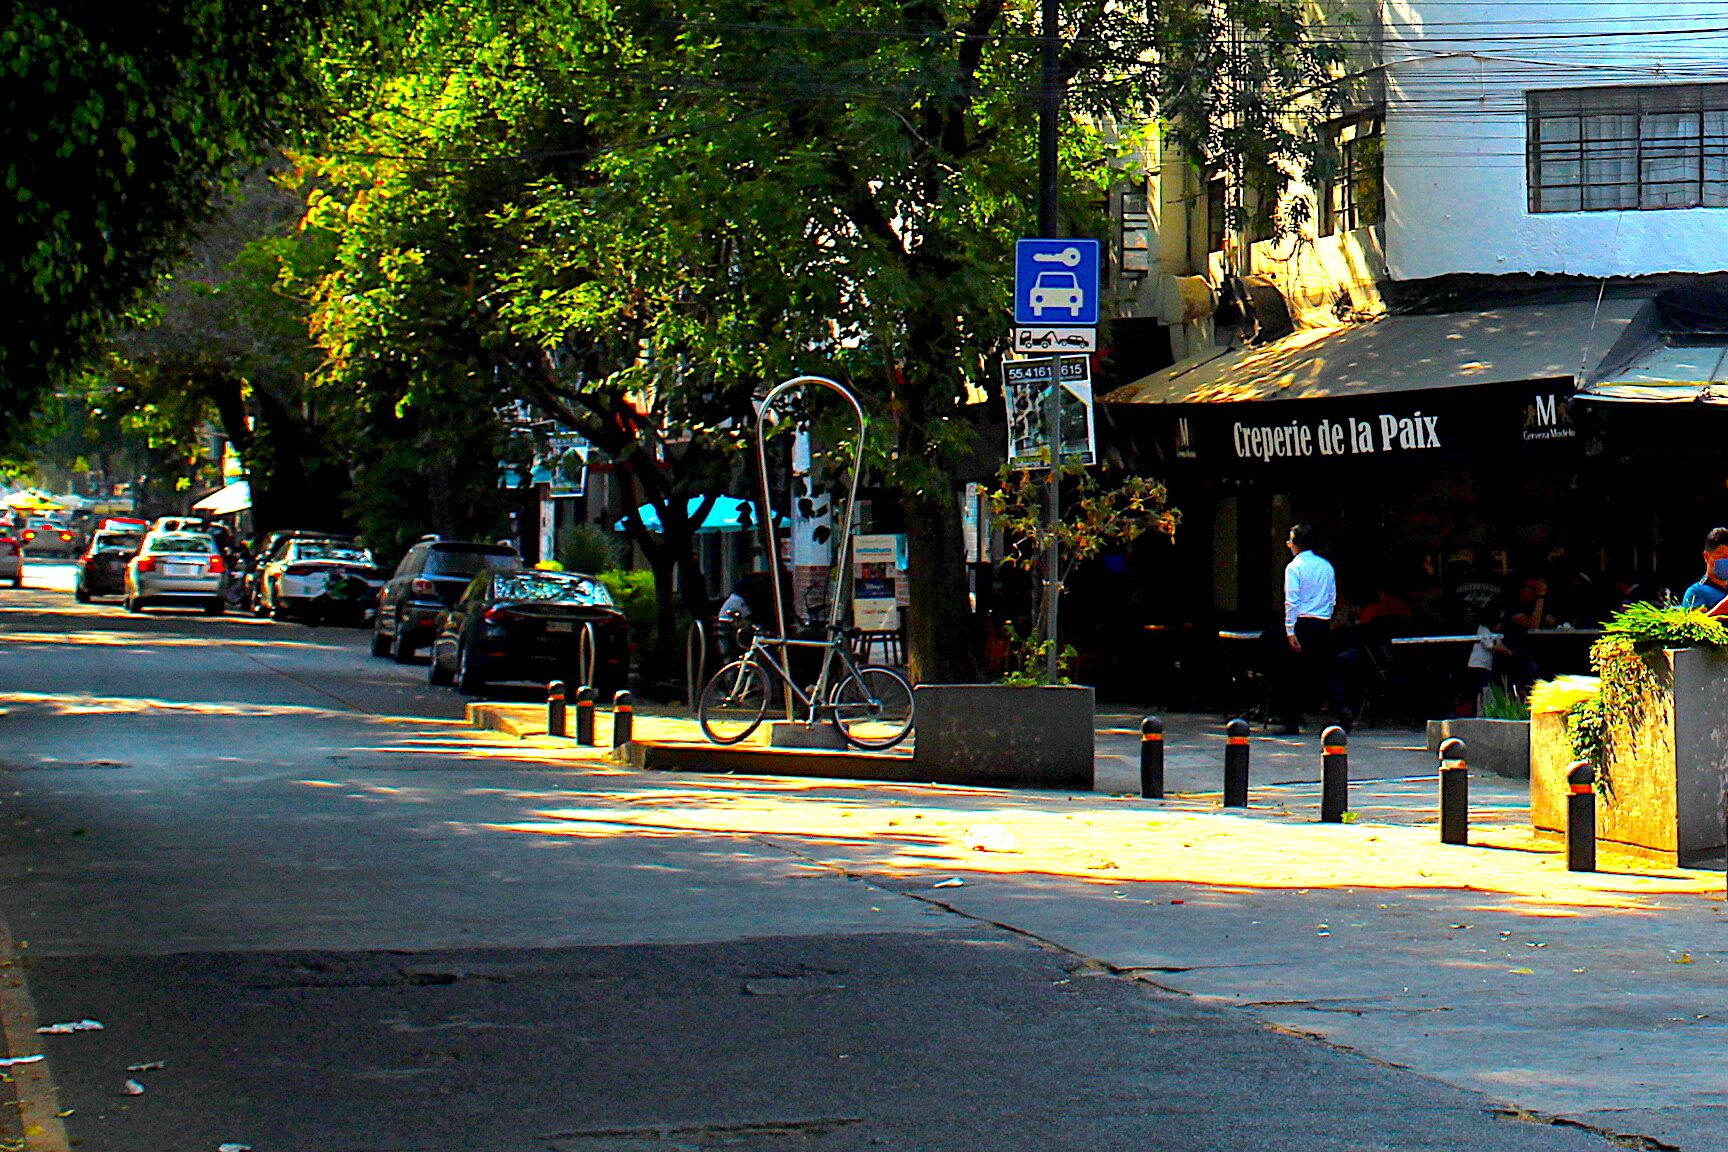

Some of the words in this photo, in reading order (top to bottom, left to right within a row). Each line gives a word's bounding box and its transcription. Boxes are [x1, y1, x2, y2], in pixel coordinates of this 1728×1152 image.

[1536, 394, 1557, 427] M
[1233, 420, 1313, 462] Creperie
[1317, 419, 1345, 456] de
[1349, 417, 1375, 454] la
[1378, 411, 1441, 451] Paix
[1550, 428, 1576, 439] Modelo
